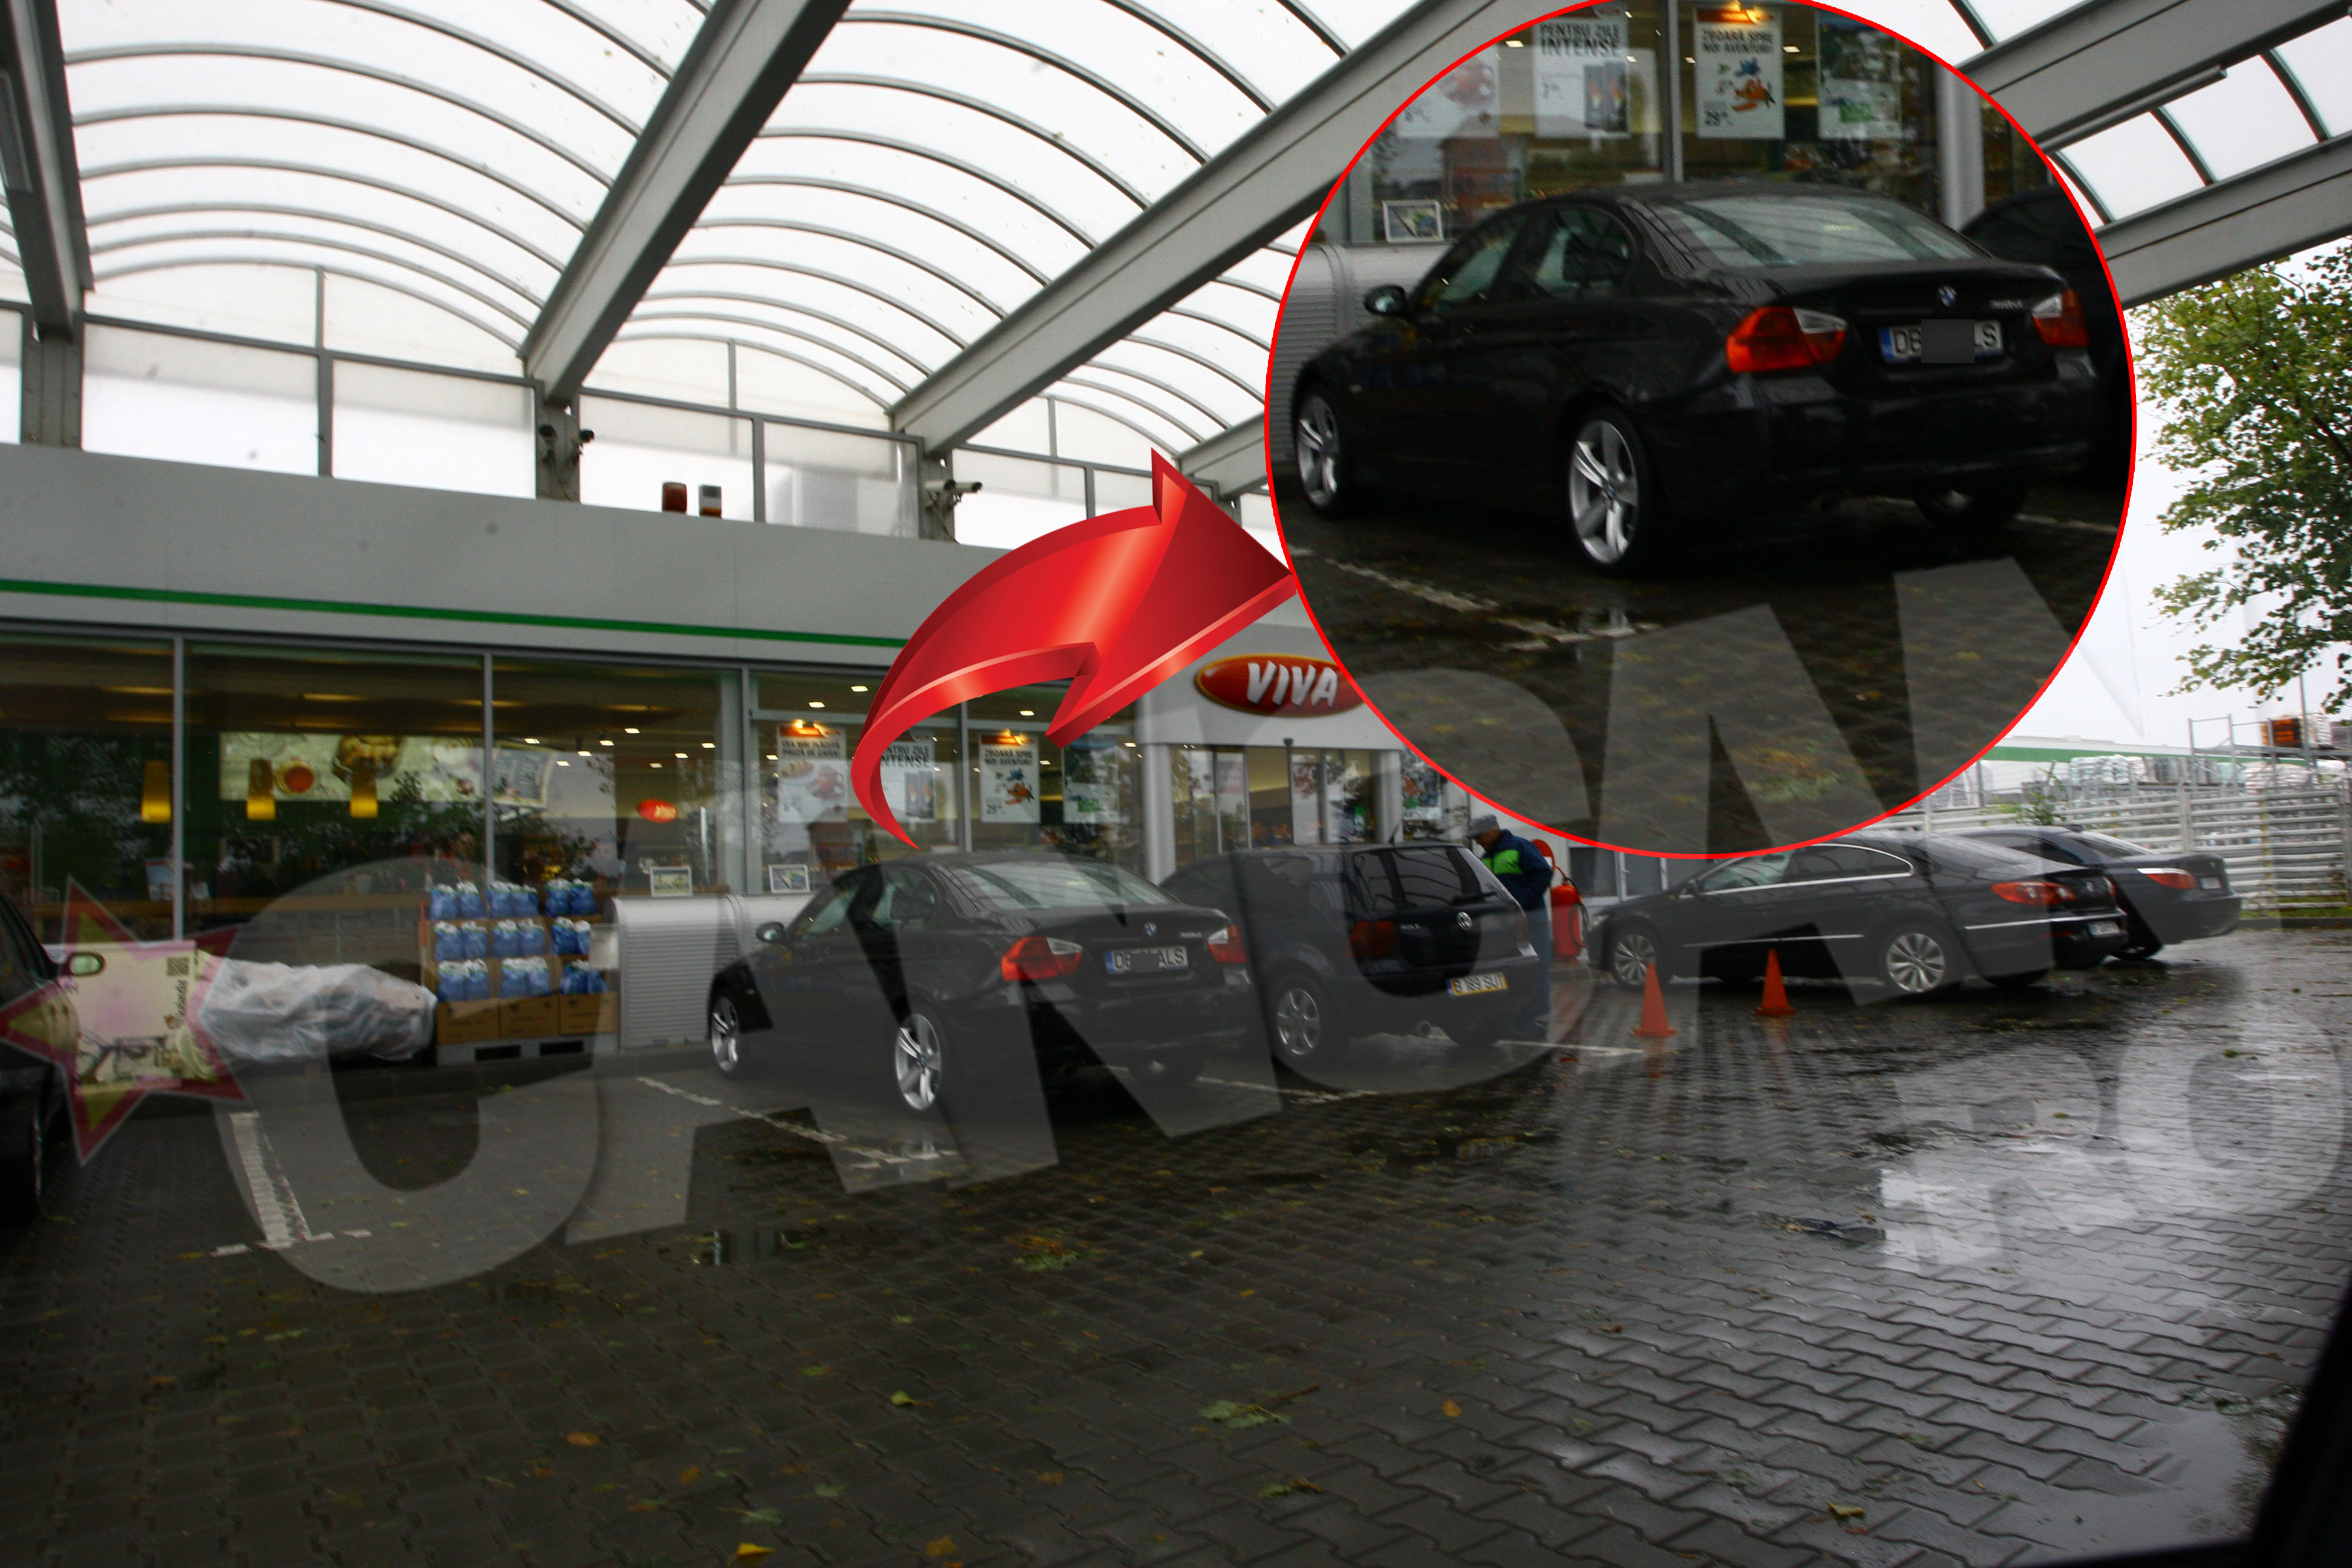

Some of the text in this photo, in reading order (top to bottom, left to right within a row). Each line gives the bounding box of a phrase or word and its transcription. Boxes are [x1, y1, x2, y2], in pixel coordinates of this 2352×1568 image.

[1541, 36, 1621, 56] INTENSE
[1247, 660, 1338, 708] VIVA
[881, 754, 929, 768] NTENSE
